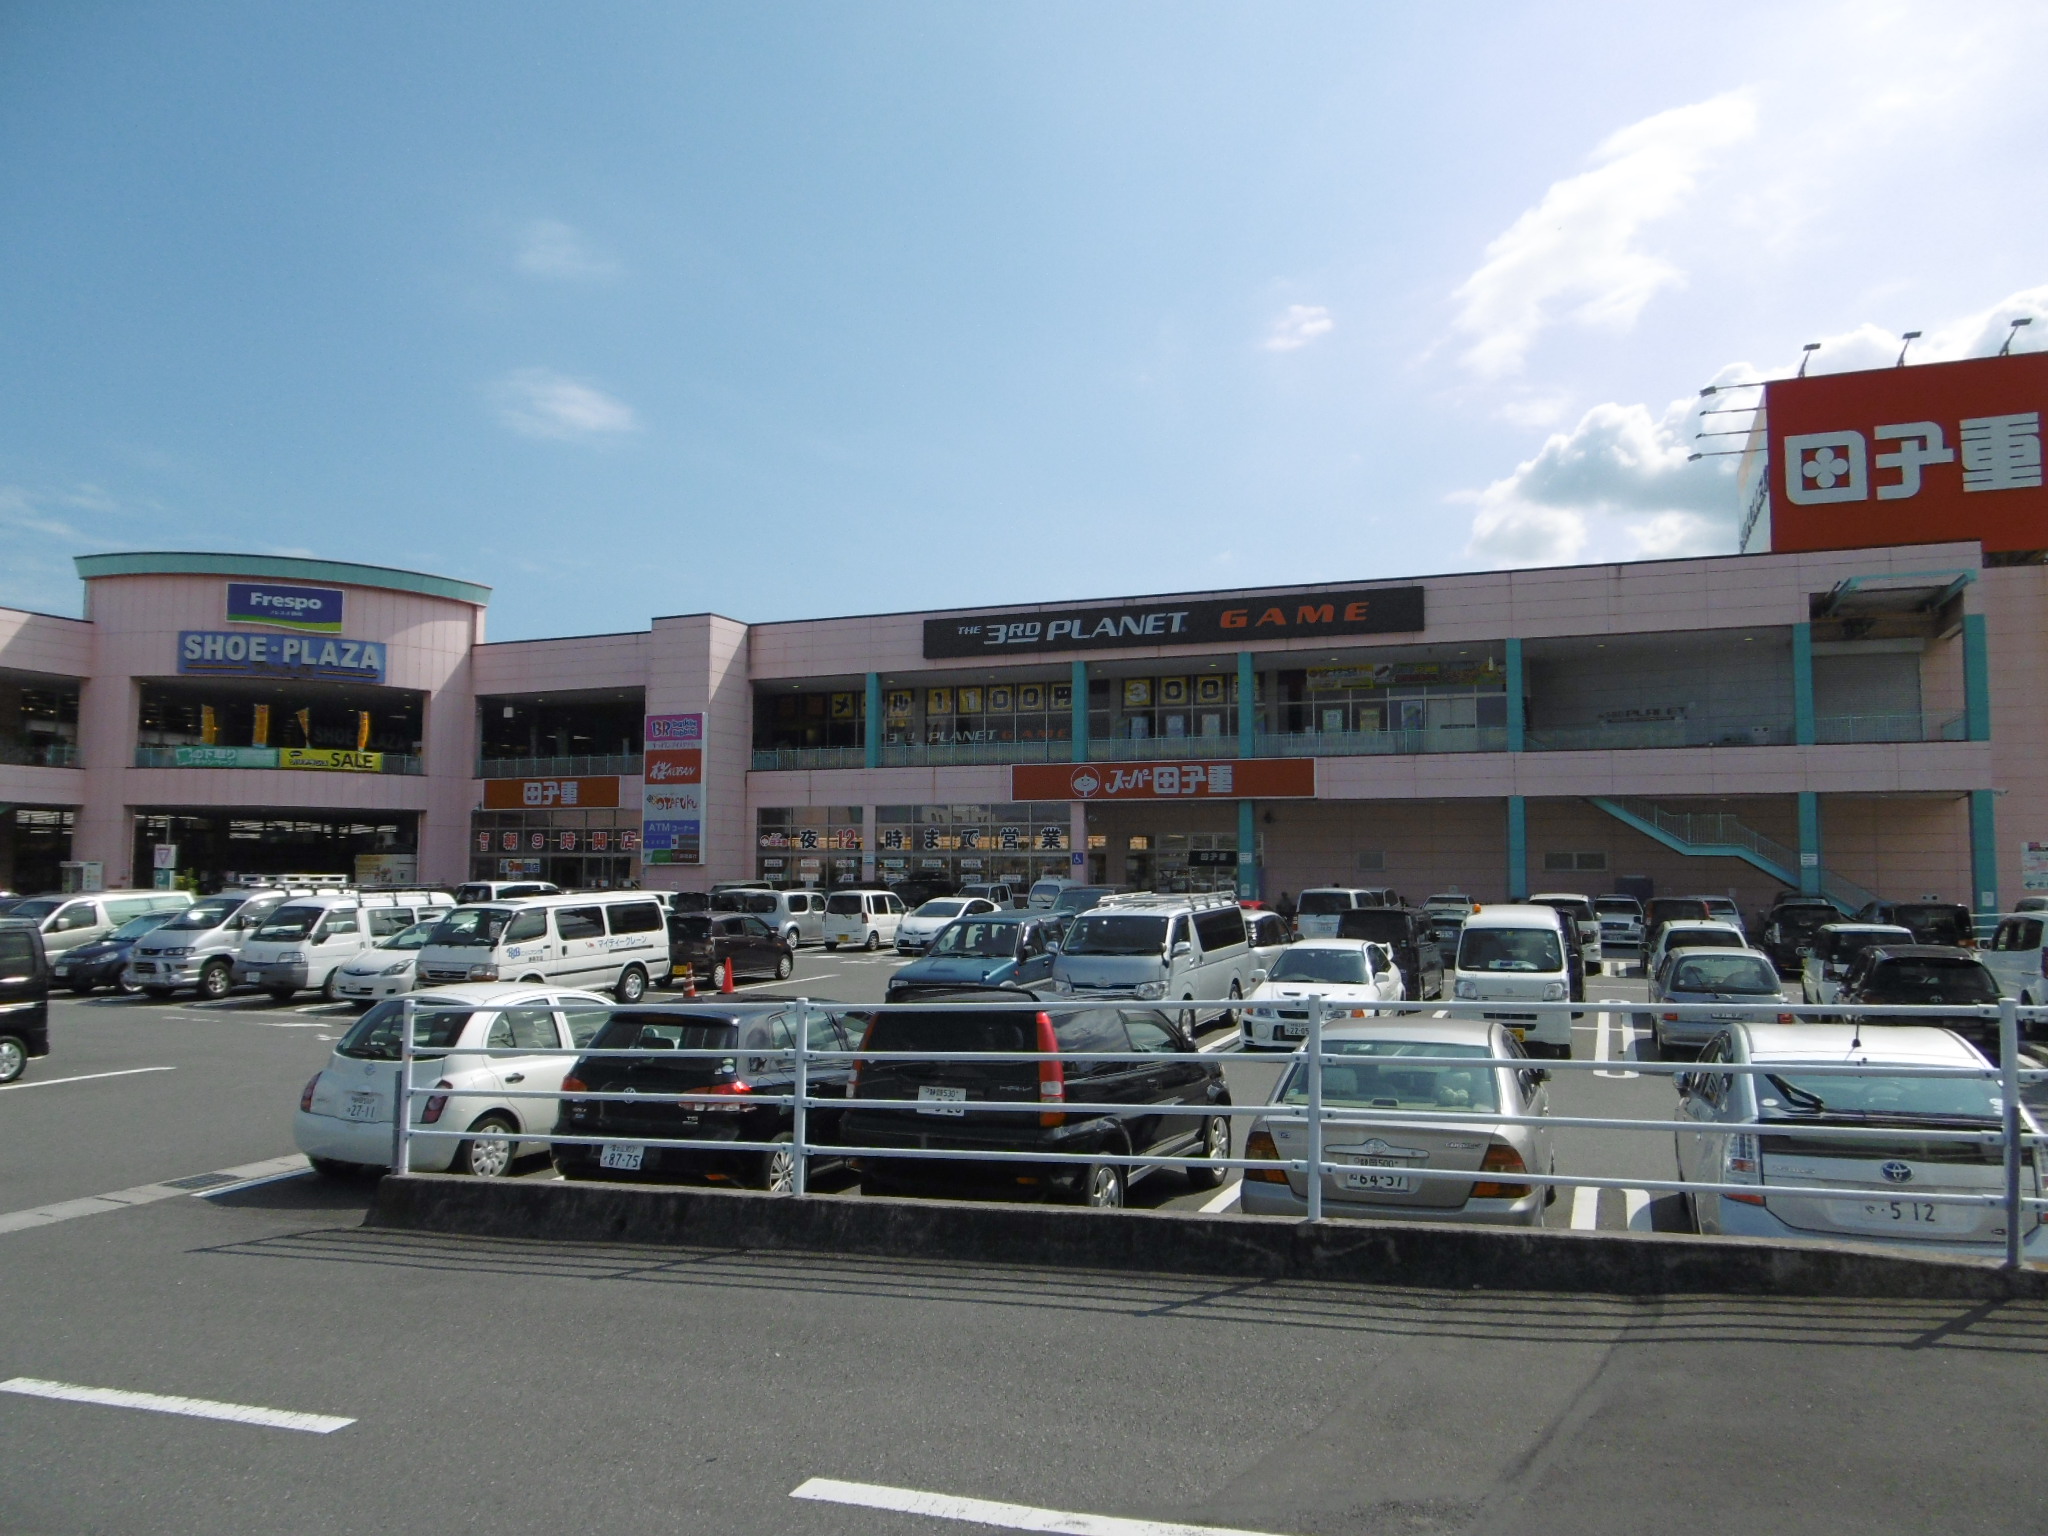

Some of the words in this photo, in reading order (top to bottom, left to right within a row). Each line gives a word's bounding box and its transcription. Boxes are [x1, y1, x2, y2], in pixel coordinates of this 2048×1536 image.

[250, 592, 322, 610] Frespo
[957, 626, 981, 635] THE
[983, 622, 1041, 645] 3RD
[1046, 611, 1190, 641] PLANET
[1220, 602, 1370, 629] GAME
[652, 720, 671, 737] BR
[928, 729, 997, 743] PLANET
[330, 752, 375, 769] SALE
[648, 822, 670, 832] ATM
[350, 1104, 375, 1118] 27-11
[608, 1152, 640, 1168] 87-75
